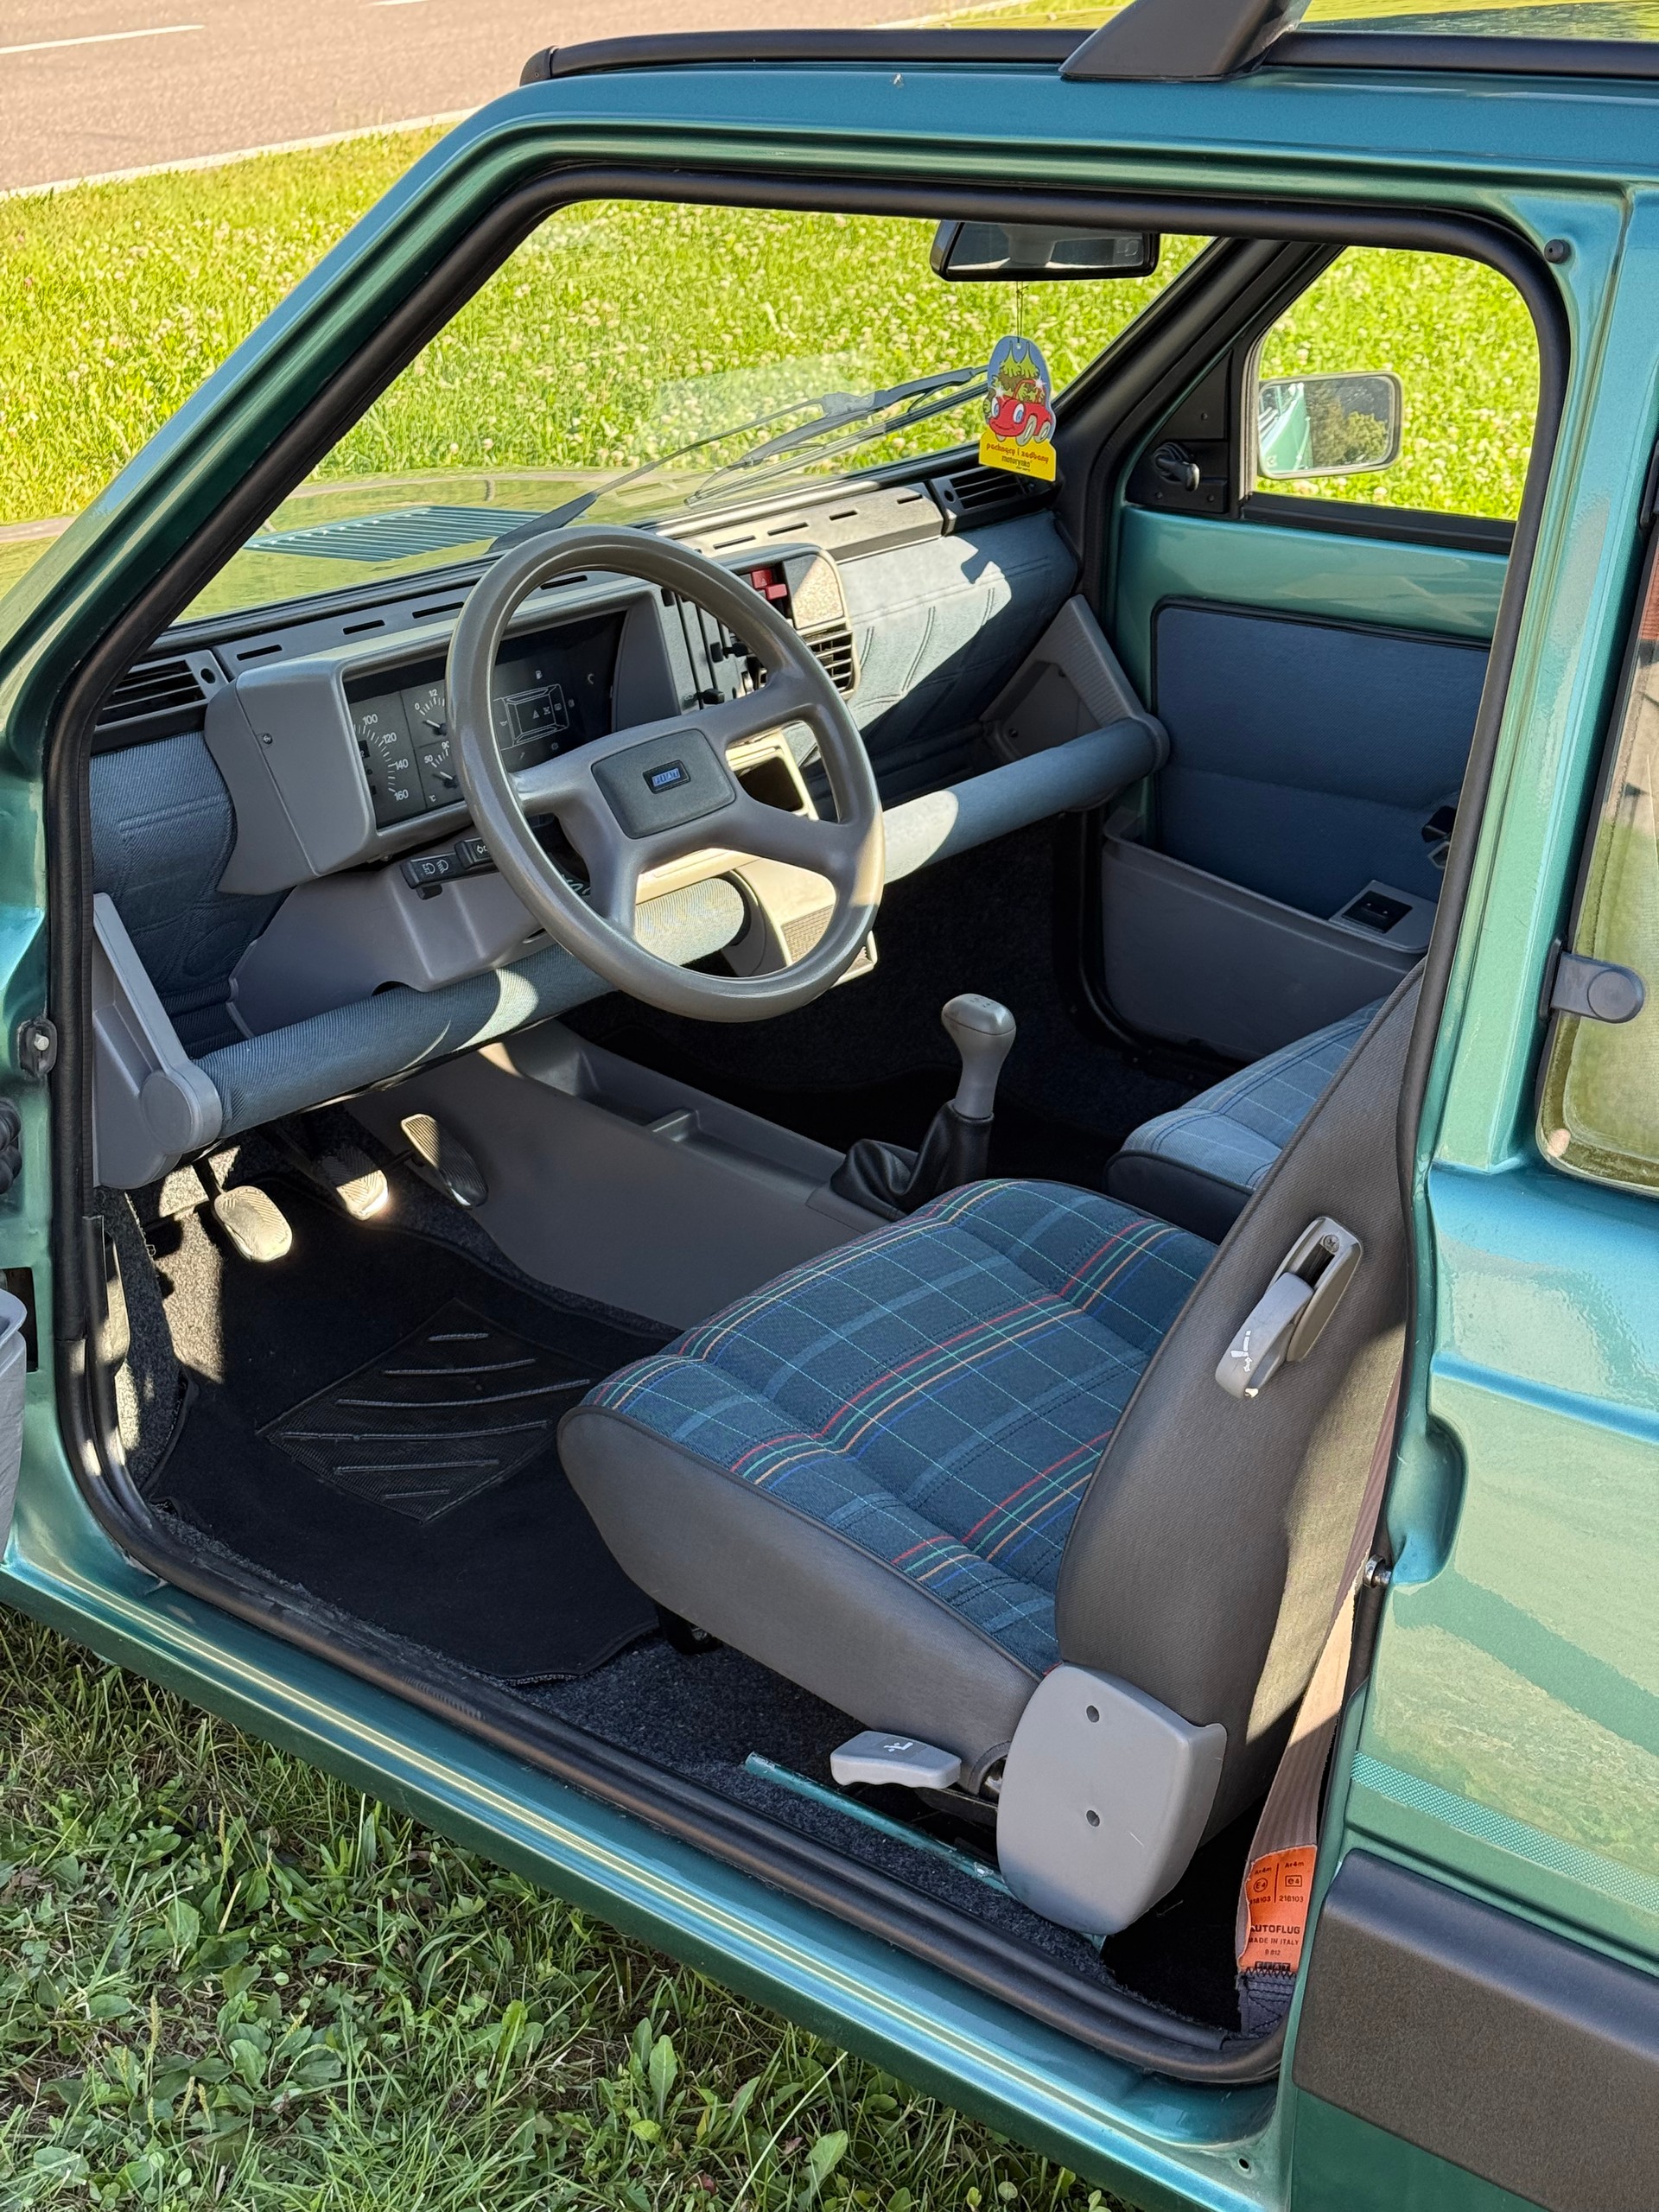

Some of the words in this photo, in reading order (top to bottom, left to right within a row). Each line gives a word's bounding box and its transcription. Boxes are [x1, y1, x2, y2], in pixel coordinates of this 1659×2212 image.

[362, 714, 378, 726] 100
[382, 732, 397, 744] 120
[395, 759, 409, 771] 140
[424, 754, 434, 764] 50
[652, 767, 681, 787] FIAT
[394, 789, 409, 802] 160
